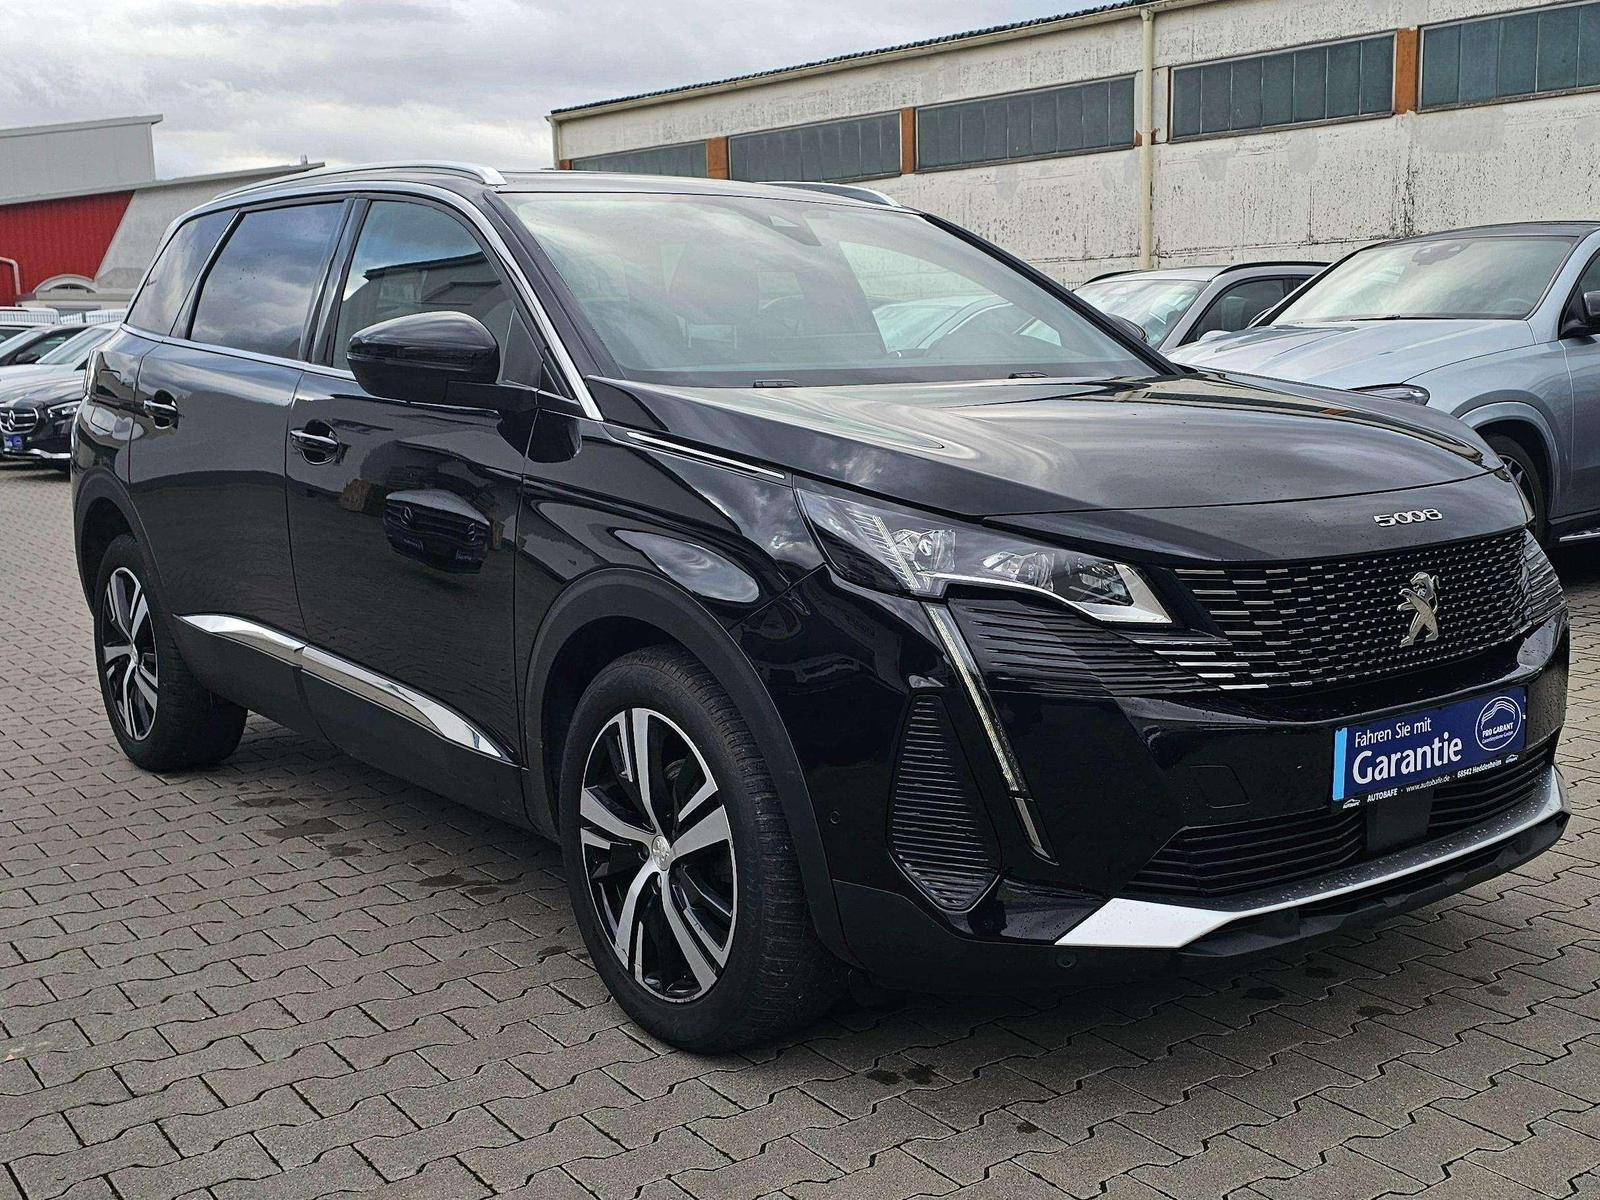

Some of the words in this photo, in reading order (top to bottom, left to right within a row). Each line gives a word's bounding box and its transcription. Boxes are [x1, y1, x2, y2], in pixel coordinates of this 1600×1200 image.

[1374, 508, 1442, 527] 5008
[1355, 727, 1391, 748] Fahren
[1395, 722, 1410, 739] Sie
[1414, 717, 1432, 734] mit
[1482, 729, 1492, 738] PRO
[1493, 722, 1514, 735] GARANT
[1352, 732, 1462, 785] Garantie
